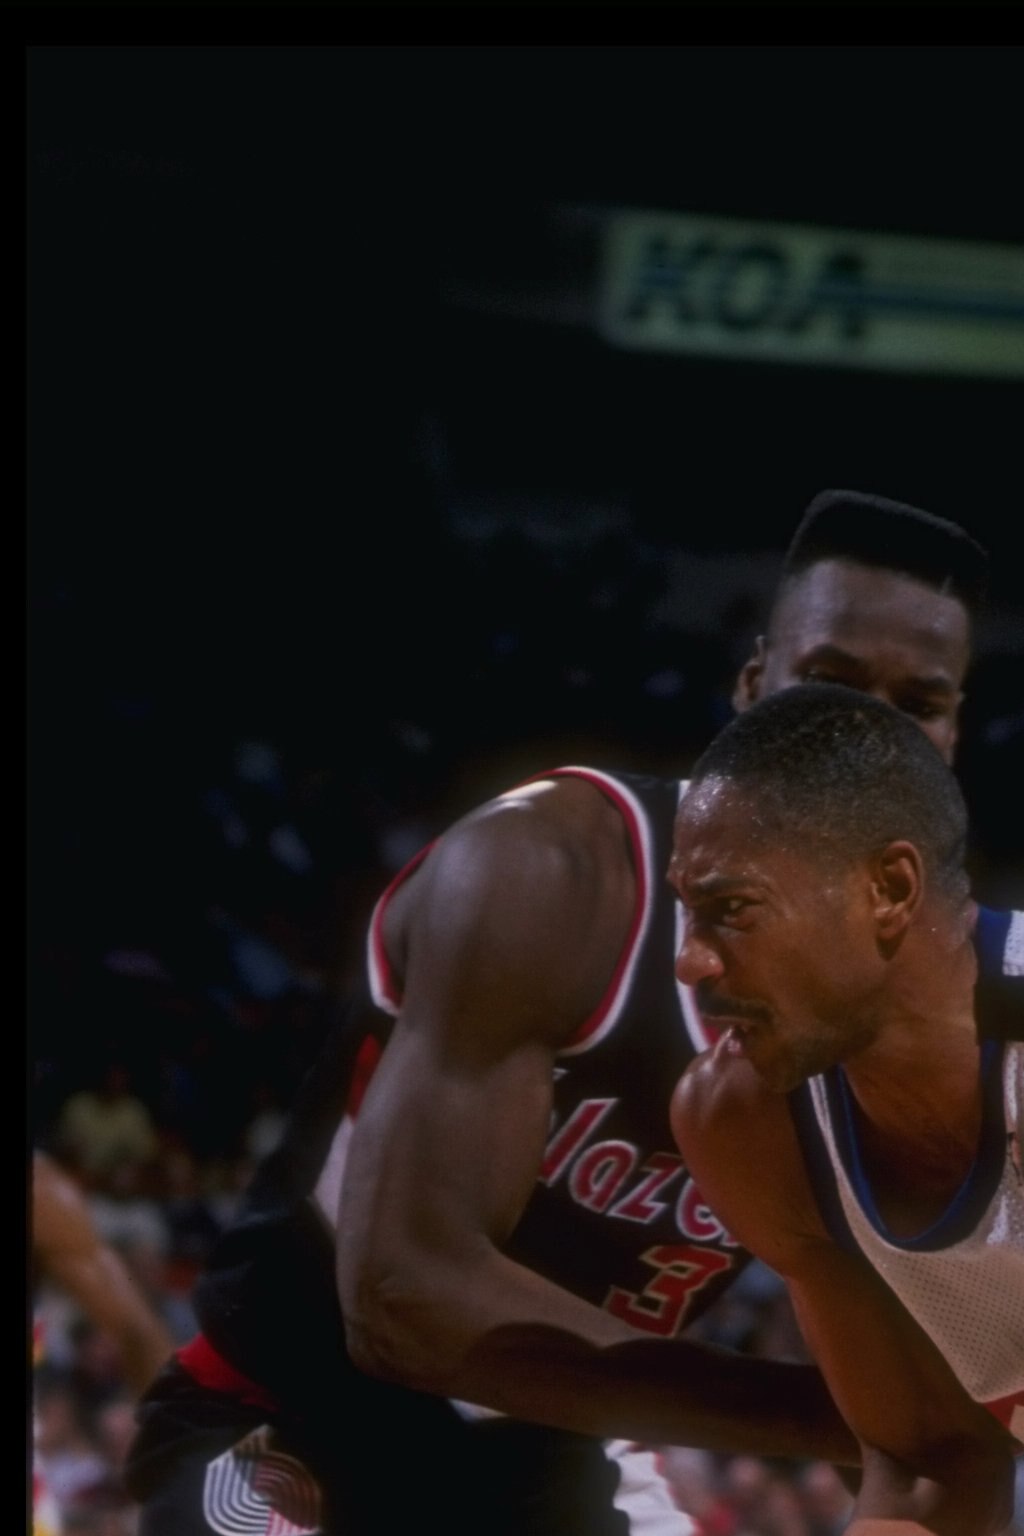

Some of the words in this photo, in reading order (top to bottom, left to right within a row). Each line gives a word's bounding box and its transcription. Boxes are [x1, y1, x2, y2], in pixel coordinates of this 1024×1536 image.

[626, 233, 867, 341] KOA
[539, 1068, 742, 1248] laze
[601, 1244, 733, 1338] 3
